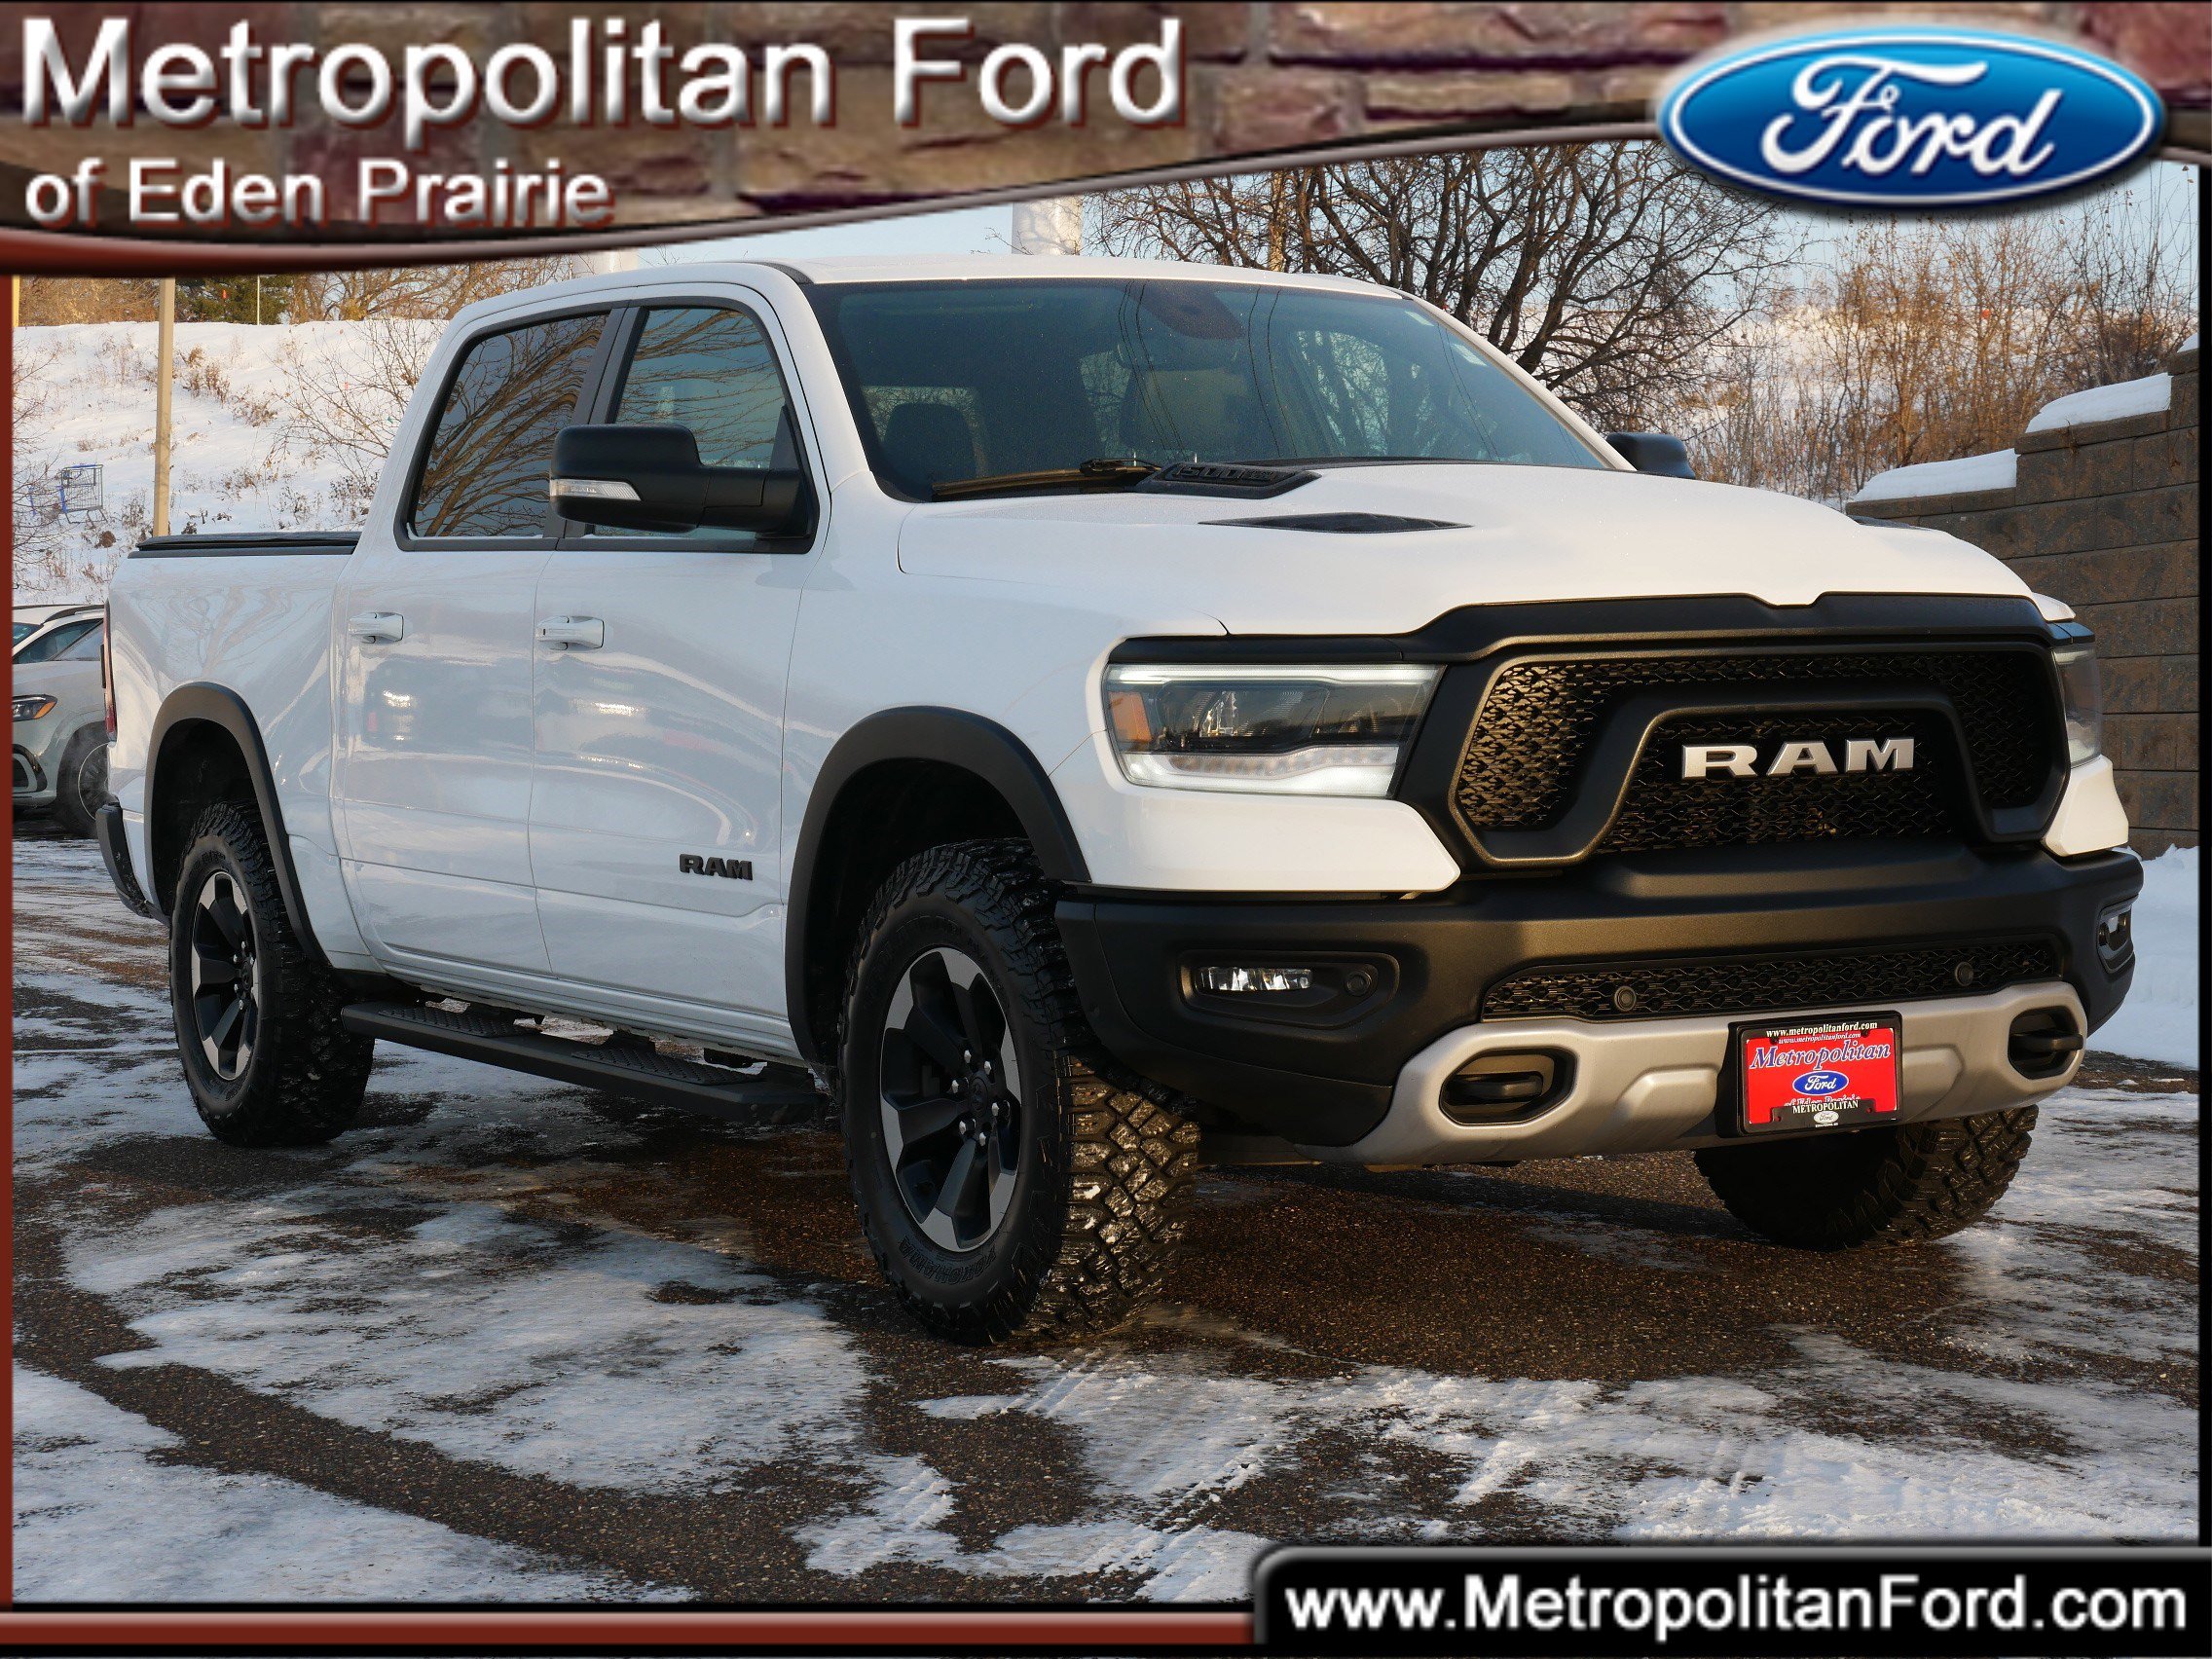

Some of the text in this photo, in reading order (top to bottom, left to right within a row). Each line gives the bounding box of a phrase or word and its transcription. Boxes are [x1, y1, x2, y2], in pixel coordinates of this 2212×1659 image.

[1681, 737, 1915, 779] RAM
[680, 853, 754, 880] RAM
[1766, 1021, 1878, 1038] www.metropolitanford.com
[1750, 1040, 1891, 1070] Metropolitan
[1804, 1075, 1837, 1091] Ford
[1792, 1100, 1859, 1114] METROPOLITAN
